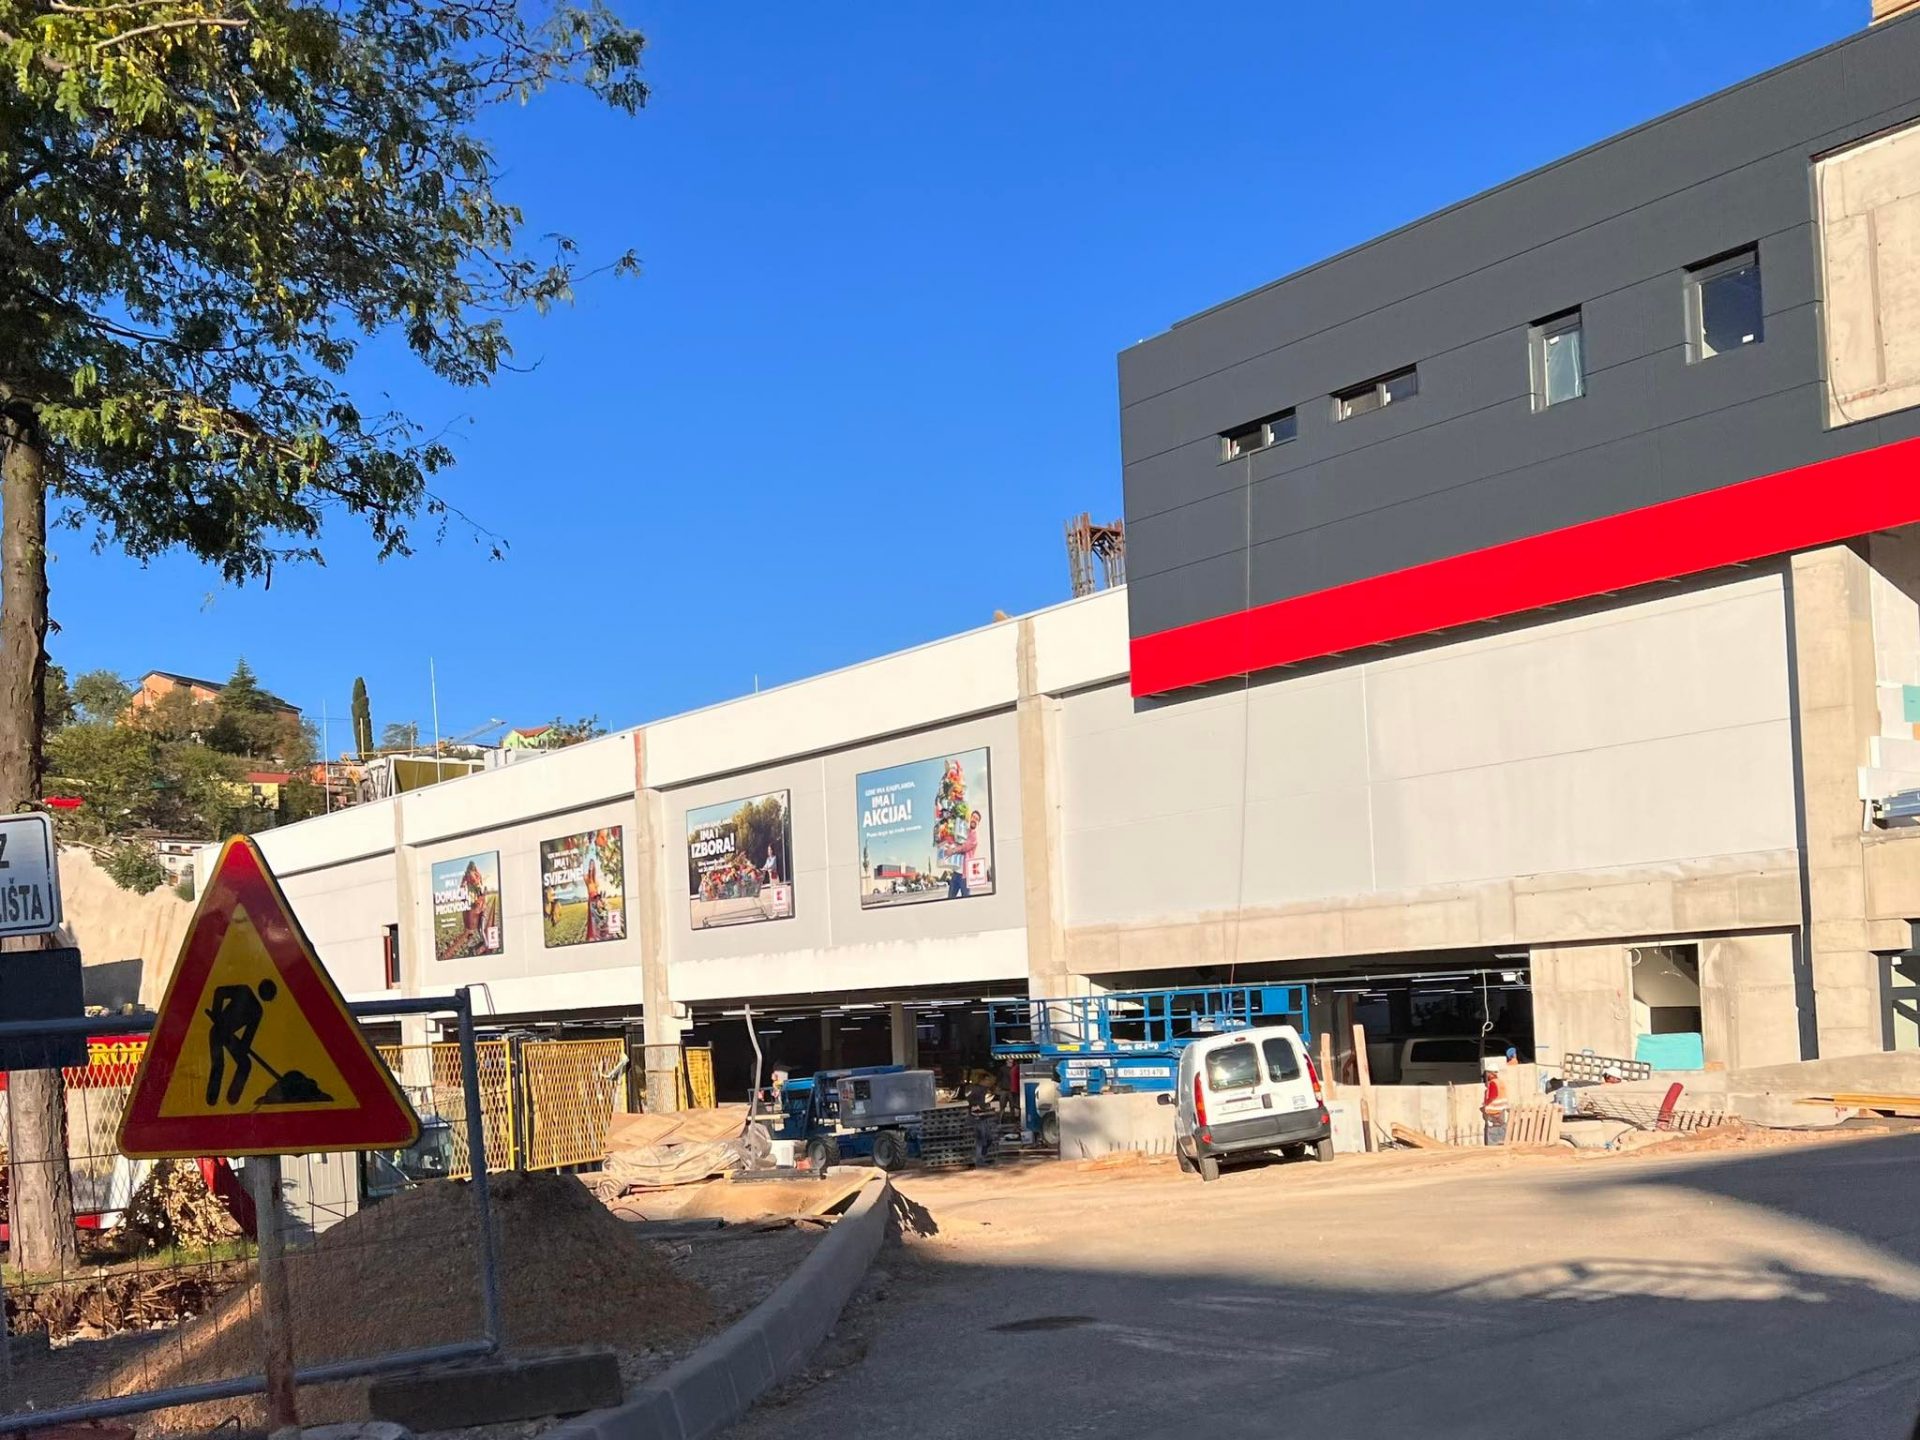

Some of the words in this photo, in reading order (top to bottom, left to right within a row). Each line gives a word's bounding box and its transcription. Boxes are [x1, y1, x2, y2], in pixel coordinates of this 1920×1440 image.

[863, 799, 912, 828] AKCIJA!
[872, 794, 890, 808] IMA
[691, 832, 735, 859] IZBORA!
[700, 828, 715, 841] IMA
[0, 877, 45, 922] IŠTA
